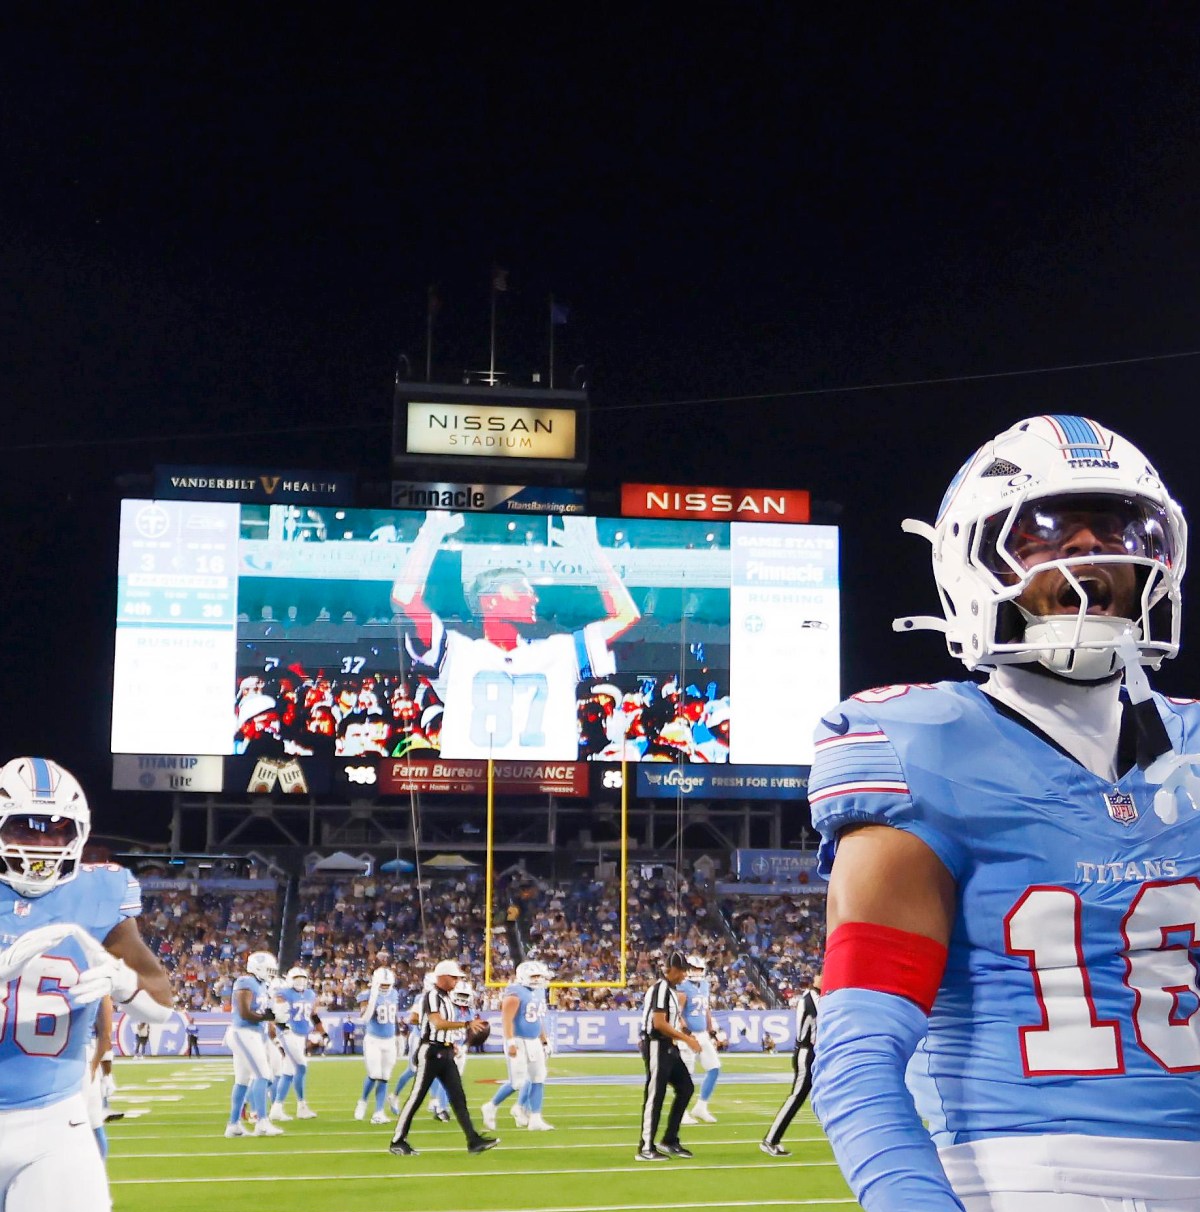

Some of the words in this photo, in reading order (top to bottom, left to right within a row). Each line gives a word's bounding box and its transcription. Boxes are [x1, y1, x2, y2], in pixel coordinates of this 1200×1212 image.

[429, 415, 553, 434] NISSAN
[449, 435, 533, 448] STADIUM
[1067, 459, 1120, 470] TITANS
[171, 477, 255, 490] VANDERBILT
[283, 482, 336, 493] HEALTH
[393, 486, 485, 508] Pinnacle
[646, 492, 786, 515] NISSAN
[507, 500, 585, 513] TitansBanking.com
[340, 656, 366, 674] 37
[469, 670, 548, 748] 87
[138, 757, 177, 769] TITAN
[179, 758, 198, 769] UP
[392, 764, 428, 777] Farm
[432, 765, 483, 778] Bureau
[488, 766, 575, 779] NSURANCE
[168, 774, 192, 789] Lite
[257, 767, 277, 780] Lite
[663, 769, 704, 793] Kroger
[711, 777, 743, 787] FRESH
[746, 777, 768, 787] FOR
[770, 778, 809, 788] EVERYO
[1111, 802, 1132, 820] NFL
[1076, 860, 1180, 884] TITANS
